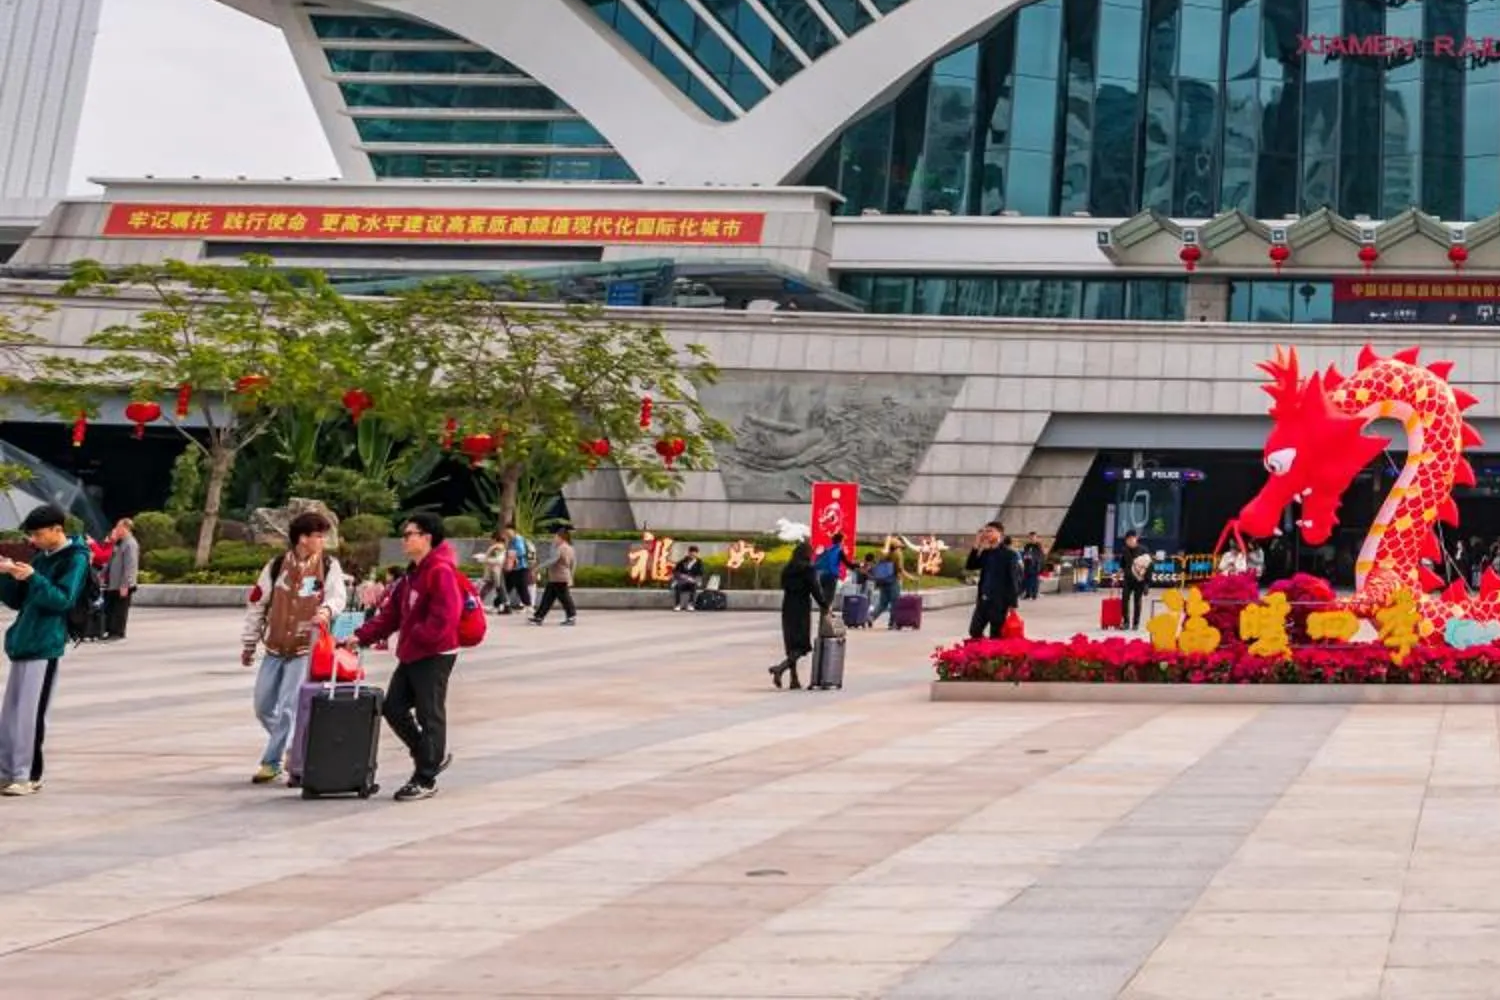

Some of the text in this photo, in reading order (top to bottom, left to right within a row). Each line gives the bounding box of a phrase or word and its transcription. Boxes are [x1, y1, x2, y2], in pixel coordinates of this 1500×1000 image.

[1296, 33, 1415, 56] XIAMEN
[127, 210, 744, 237] 牢记嘱托 践行使命 更高水平建设高素质高颜值现代化国际化城市
[1151, 471, 1180, 479] POLICE
